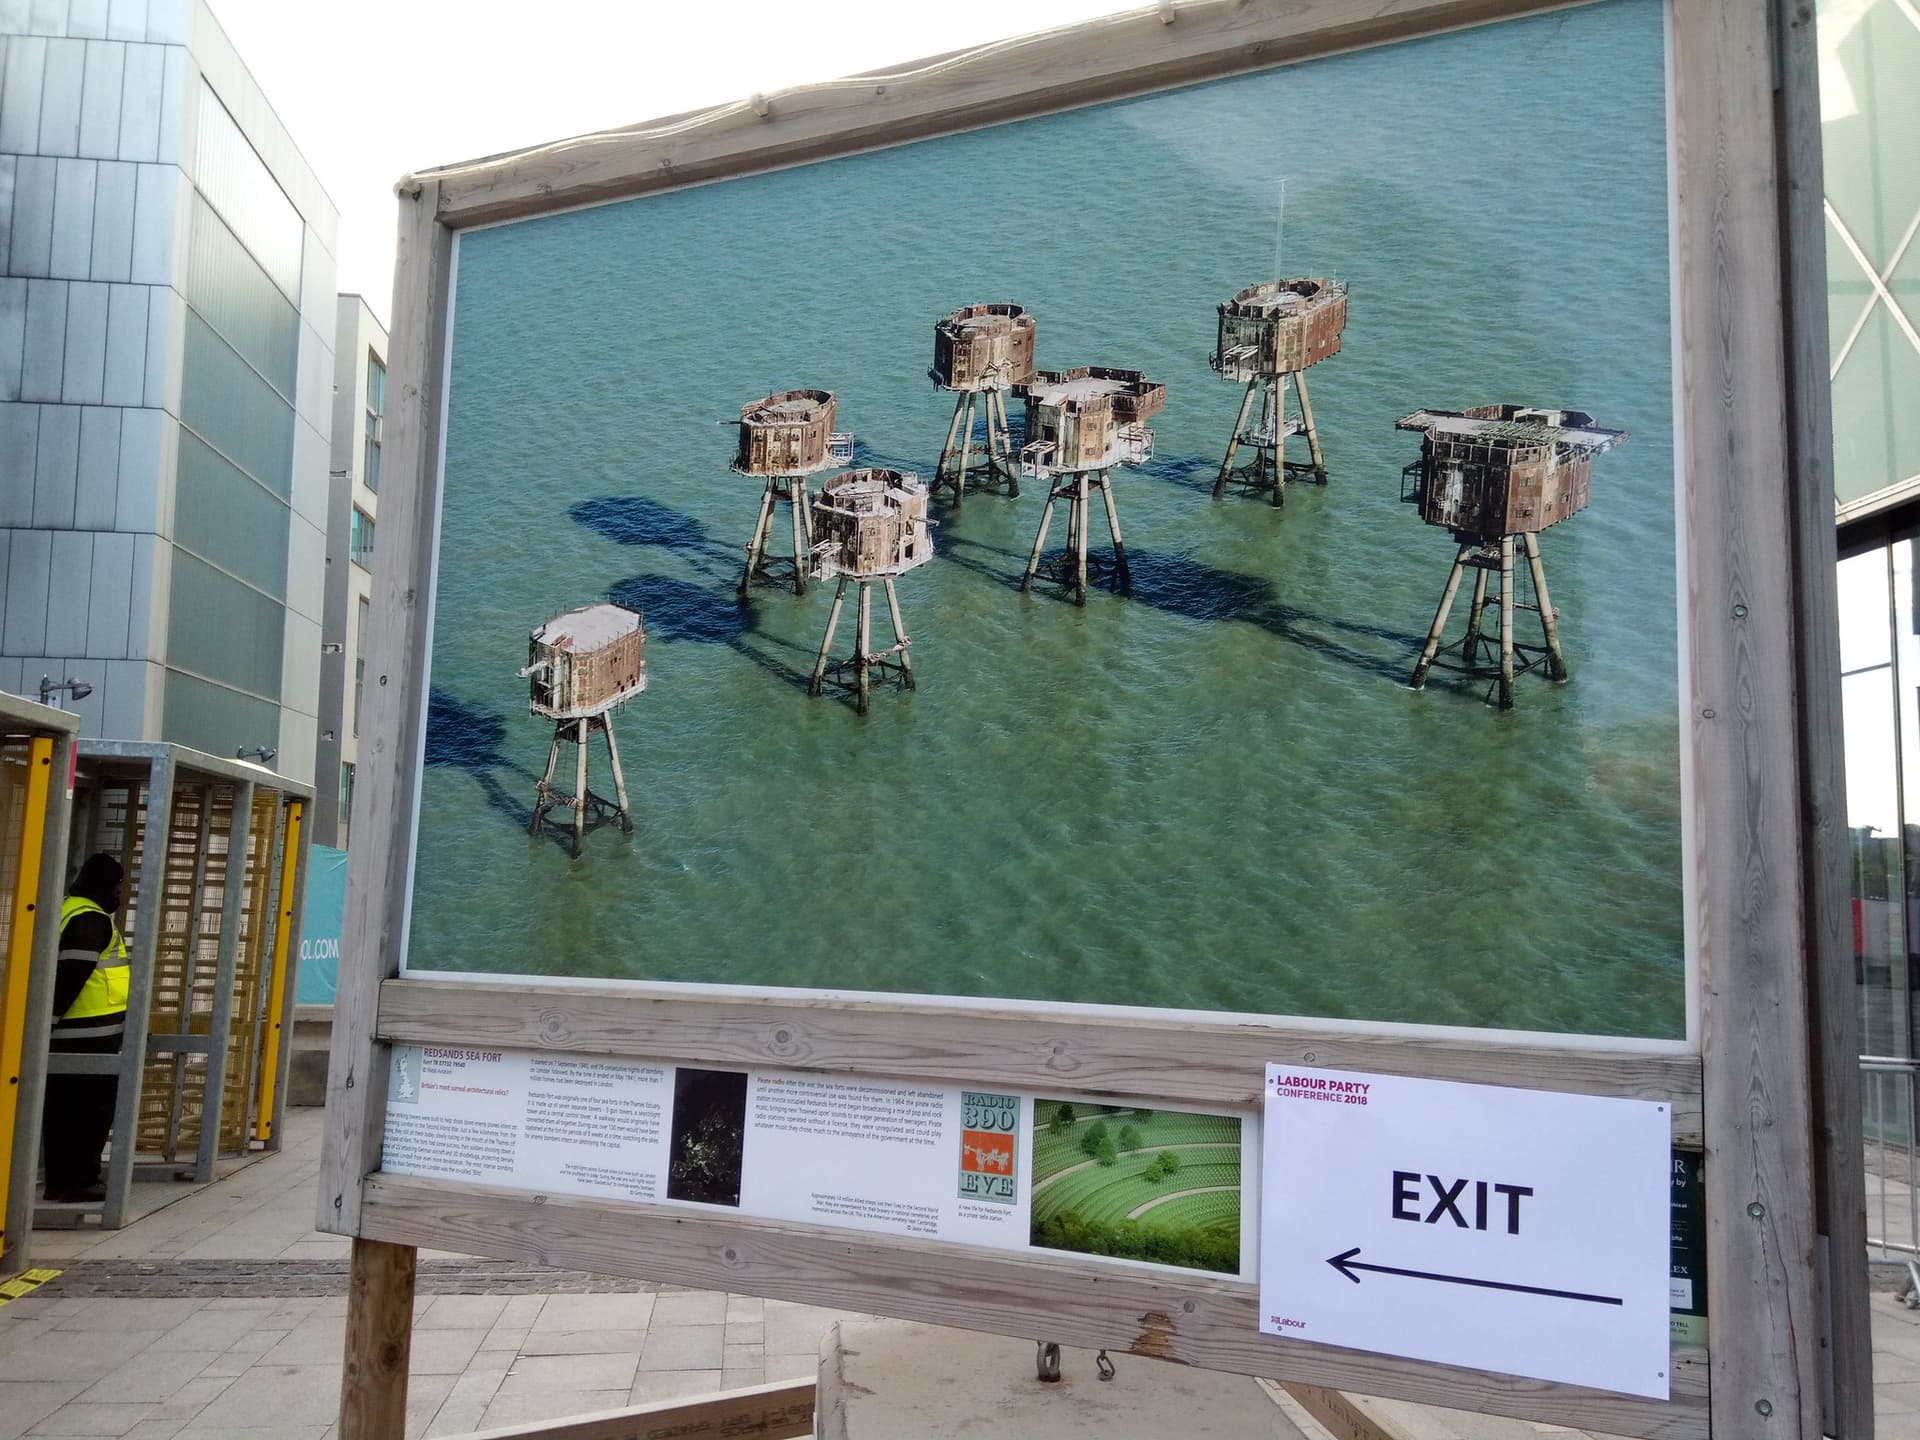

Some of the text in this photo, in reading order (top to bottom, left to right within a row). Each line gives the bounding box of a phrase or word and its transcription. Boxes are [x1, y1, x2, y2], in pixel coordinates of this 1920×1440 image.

[423, 1047, 503, 1063] REDSANDS SEA FORT
[1278, 1075, 1370, 1094] LABOUR PARTY
[964, 1094, 1016, 1109] RADIO
[1277, 1088, 1368, 1105] CONFERENCE 2018
[964, 1107, 1014, 1131] 390
[961, 1174, 1012, 1197] EYE
[1676, 1178, 1686, 1188] by
[1392, 1170, 1534, 1234] EXIT
[1279, 1317, 1306, 1328] Labour
